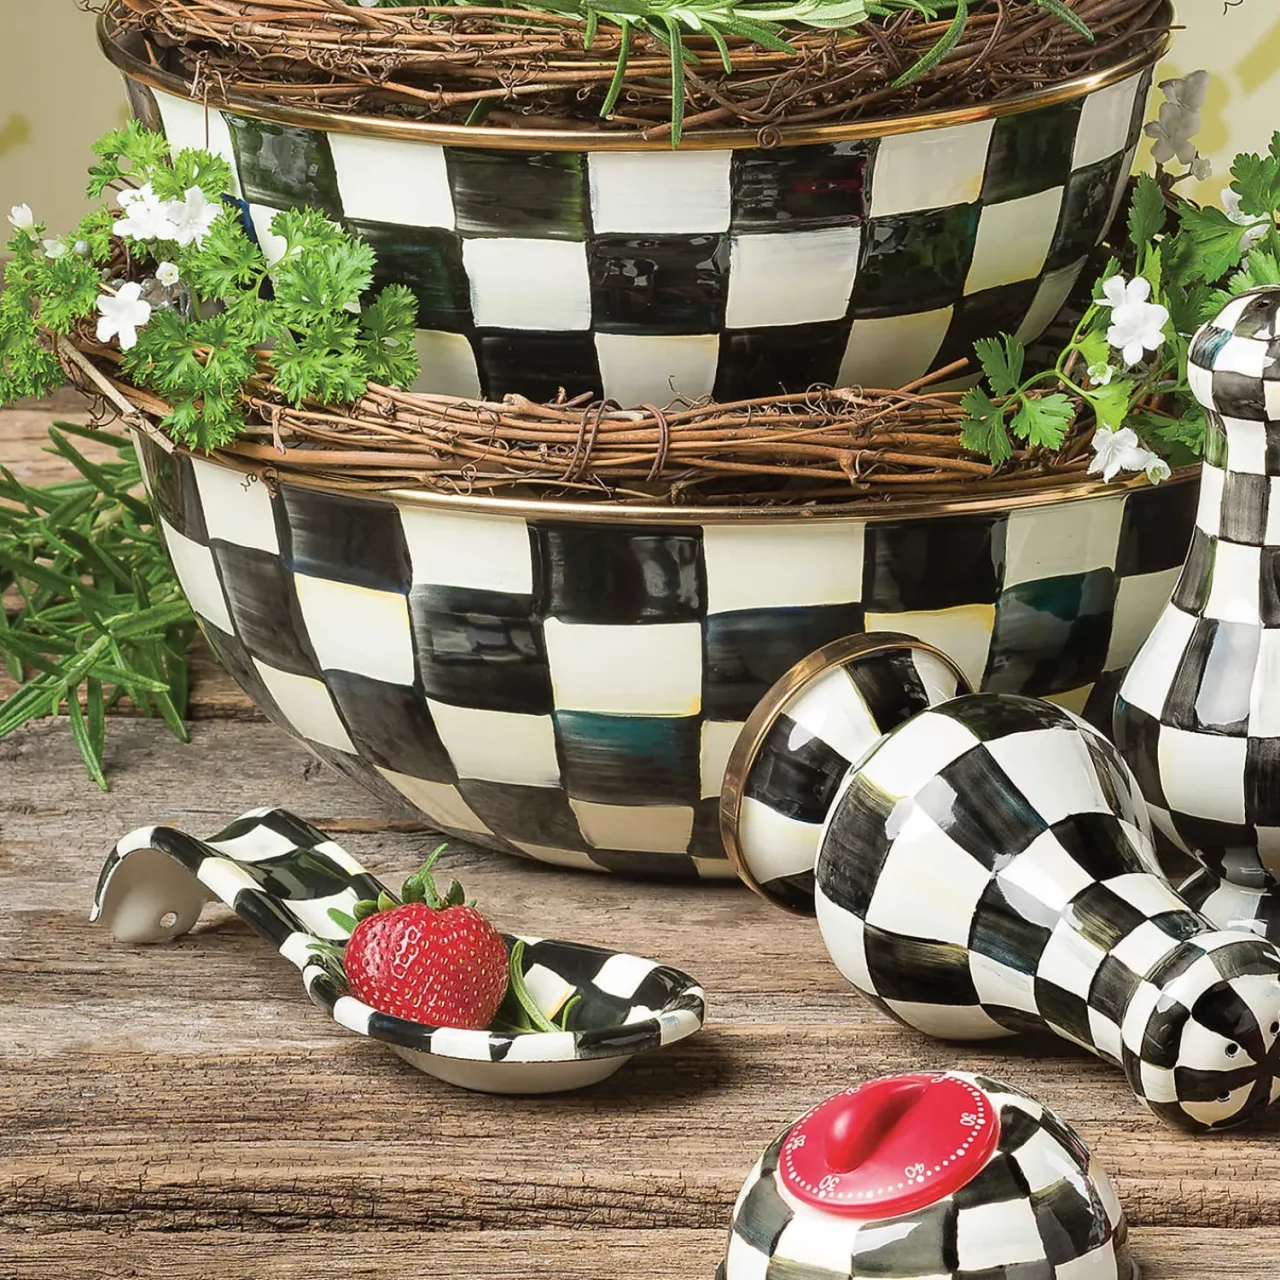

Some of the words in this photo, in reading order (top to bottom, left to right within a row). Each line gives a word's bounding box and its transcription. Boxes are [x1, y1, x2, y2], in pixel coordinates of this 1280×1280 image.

[960, 1112, 977, 1126] 50
[905, 1163, 925, 1178] 40
[819, 1175, 839, 1192] 30
